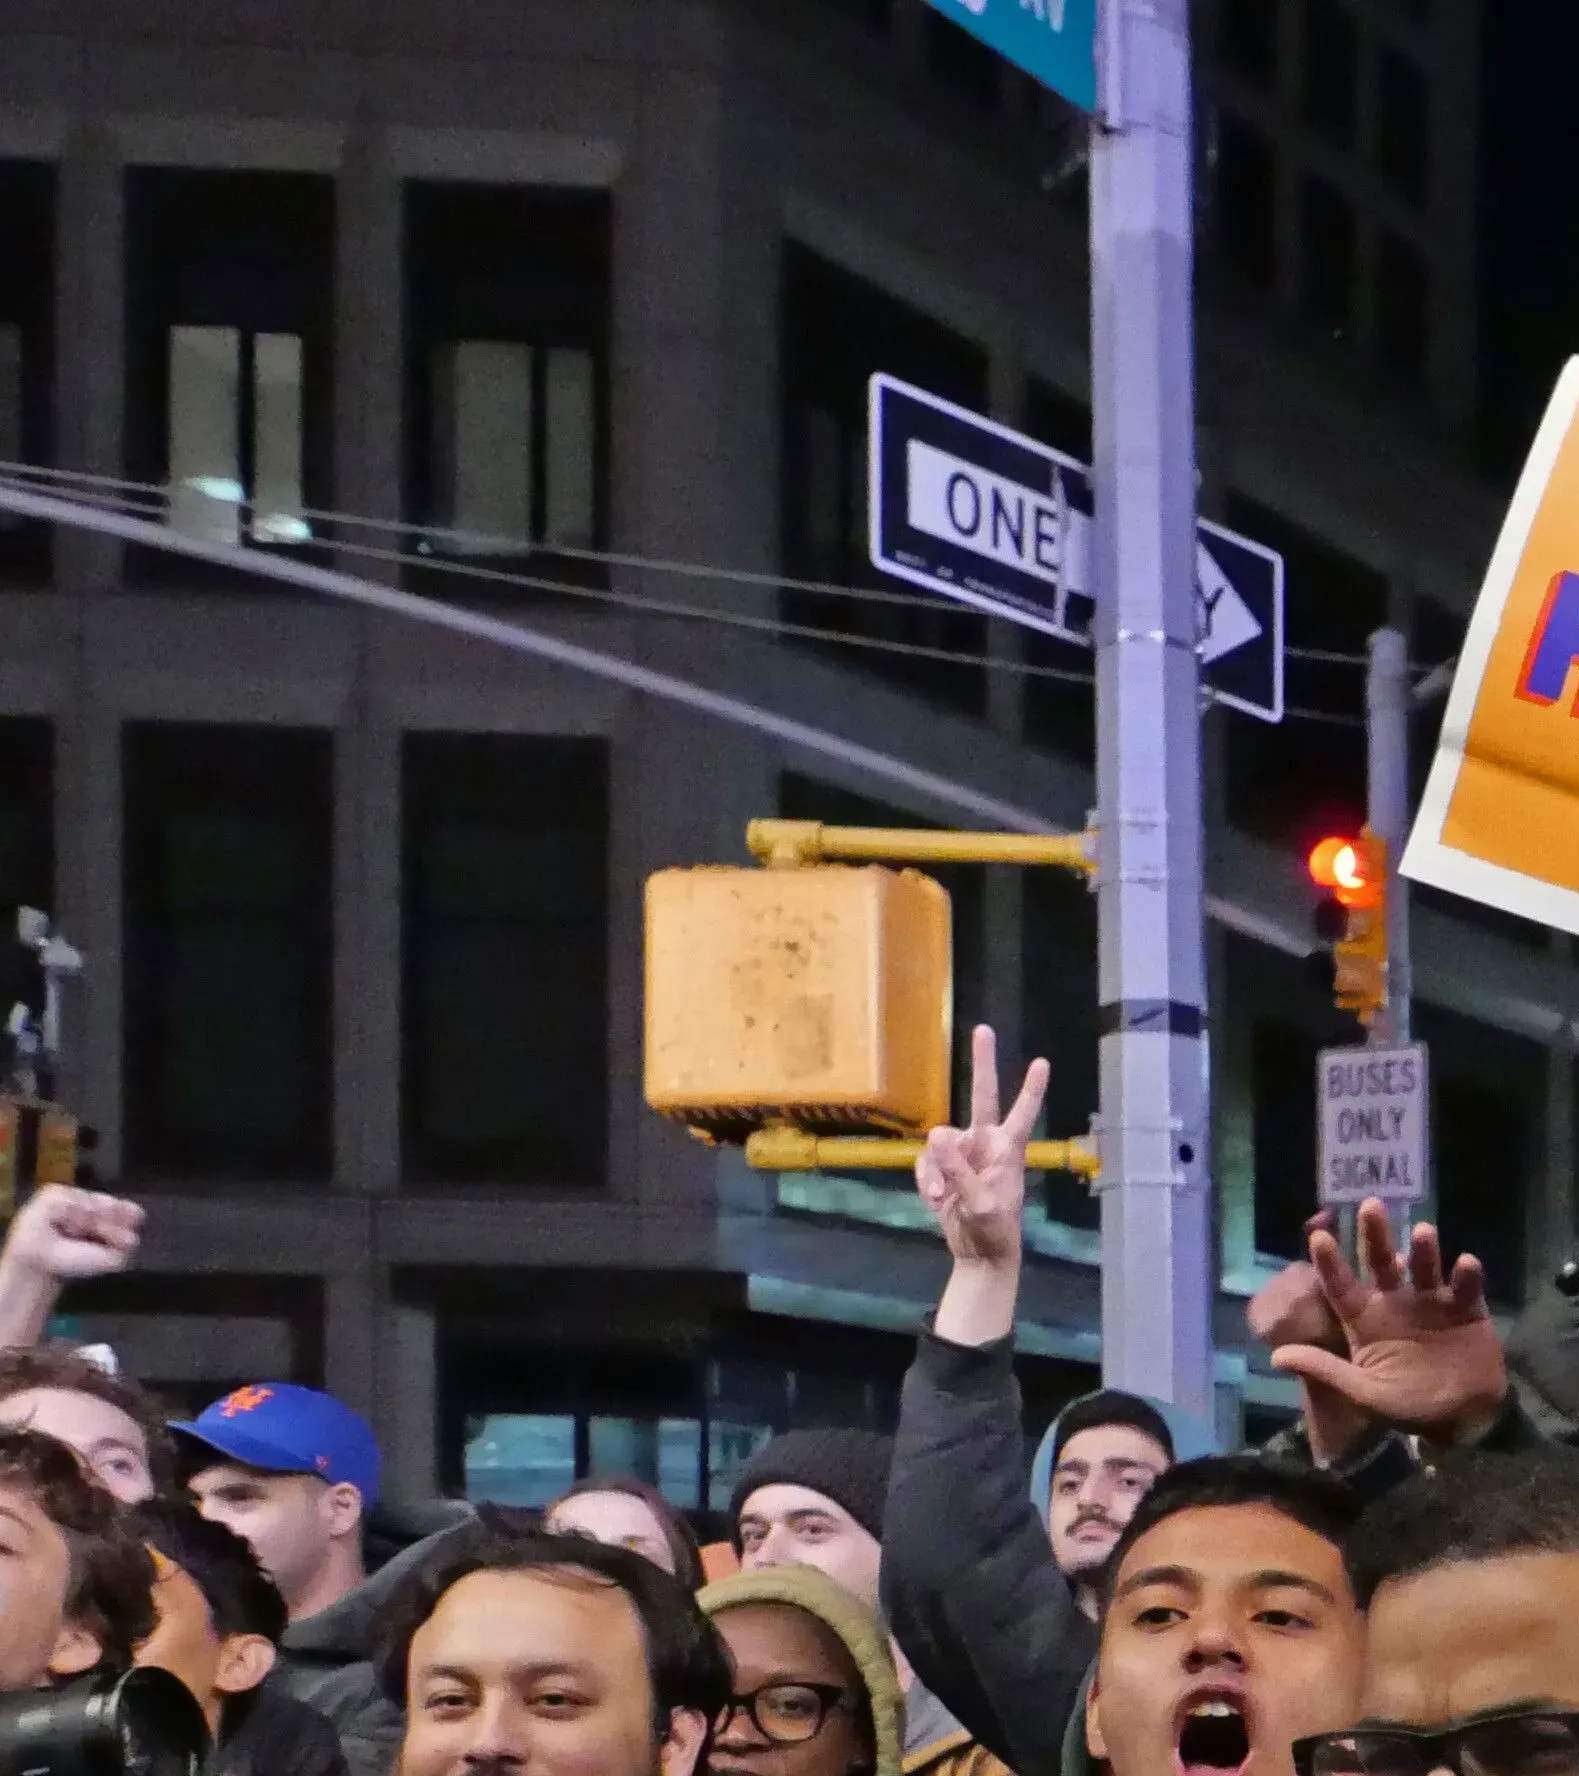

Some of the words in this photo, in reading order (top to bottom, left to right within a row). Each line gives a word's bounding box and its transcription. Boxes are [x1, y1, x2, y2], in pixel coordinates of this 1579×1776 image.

[945, 471, 1060, 573] ONE
[1327, 1057, 1416, 1099] BUSES
[1337, 1105, 1407, 1144] ONLY
[1329, 1151, 1414, 1191] SIGNAL
